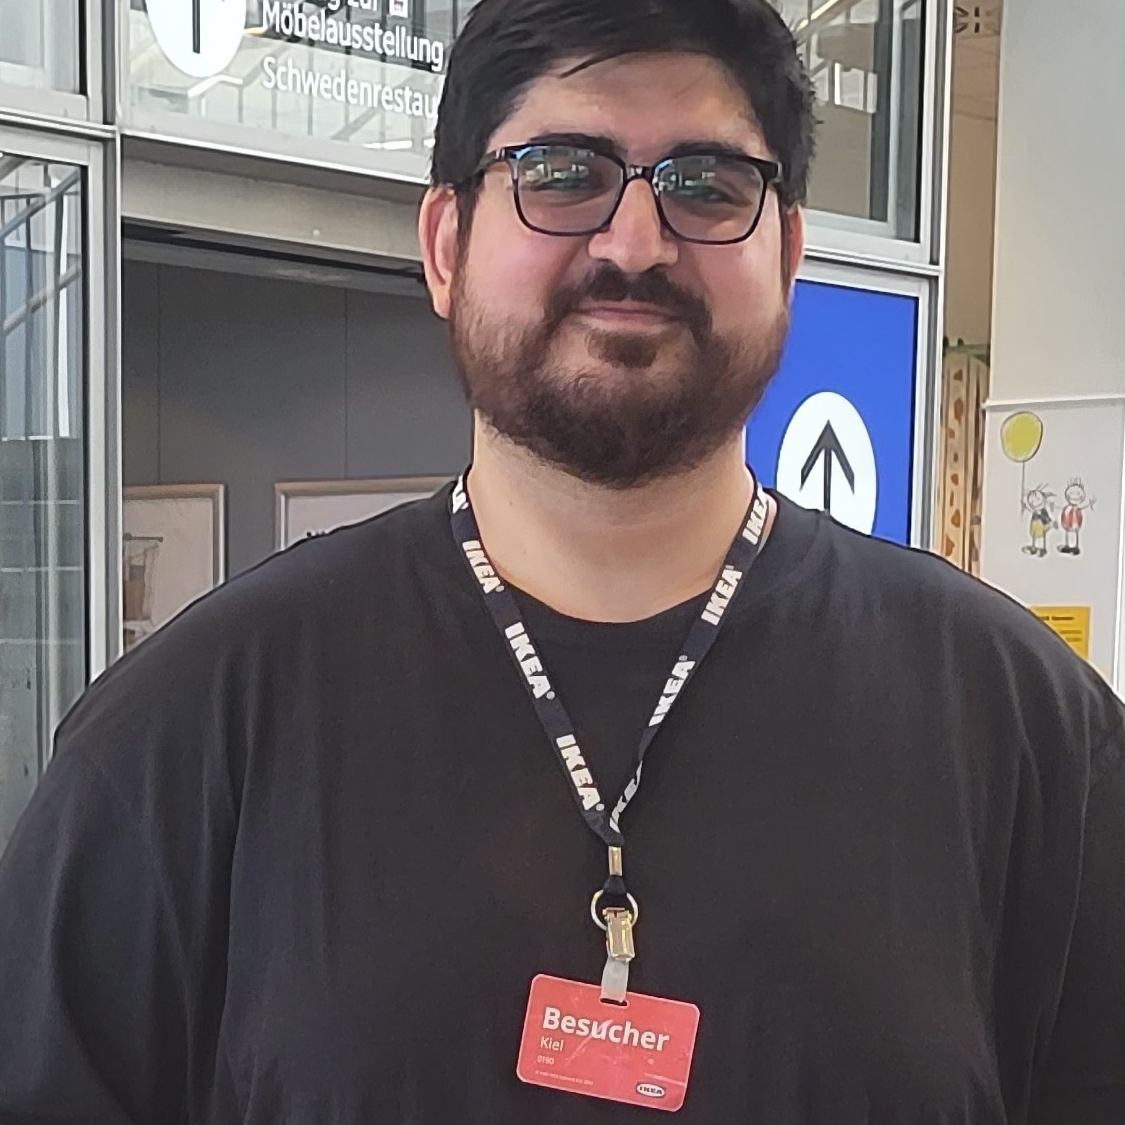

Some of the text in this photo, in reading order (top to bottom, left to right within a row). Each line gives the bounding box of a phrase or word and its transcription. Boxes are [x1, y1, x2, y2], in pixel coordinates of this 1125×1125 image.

[262, 0, 444, 72] Möbelausstellung
[262, 56, 439, 119] Schwedenrestau
[700, 564, 743, 626] IKEA
[504, 621, 556, 700] IKEA
[648, 654, 696, 727] IKEA
[556, 733, 605, 811] IKEA
[540, 1036, 565, 1052] Kiel
[542, 1006, 671, 1052] Besucher
